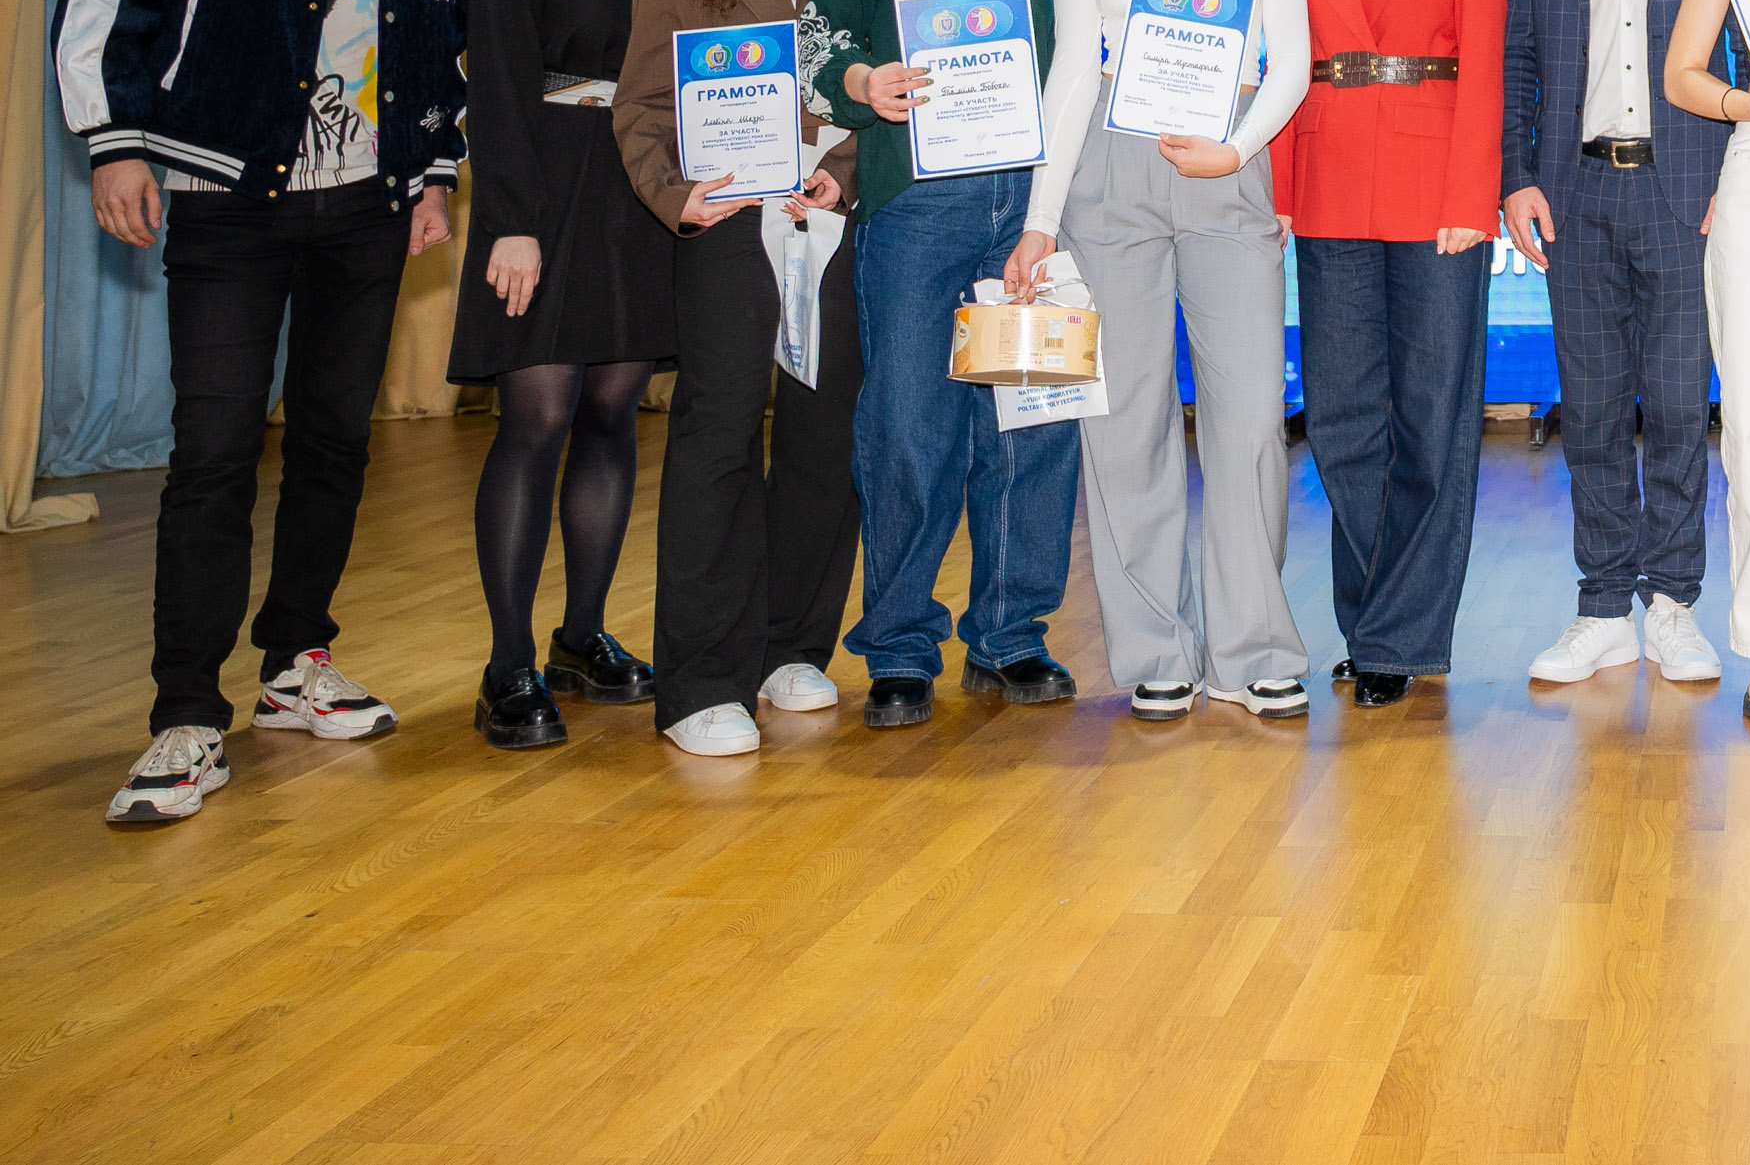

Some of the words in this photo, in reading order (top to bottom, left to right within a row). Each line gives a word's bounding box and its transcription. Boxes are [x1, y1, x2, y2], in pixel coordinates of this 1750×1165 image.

[1145, 24, 1225, 49] ГРАМОТА
[928, 50, 1014, 70] ГРАМОТА
[1171, 71, 1199, 80] УЧАСТЬ
[698, 84, 778, 101] ГРАМОТА
[967, 97, 997, 105] УЧАСТЬ
